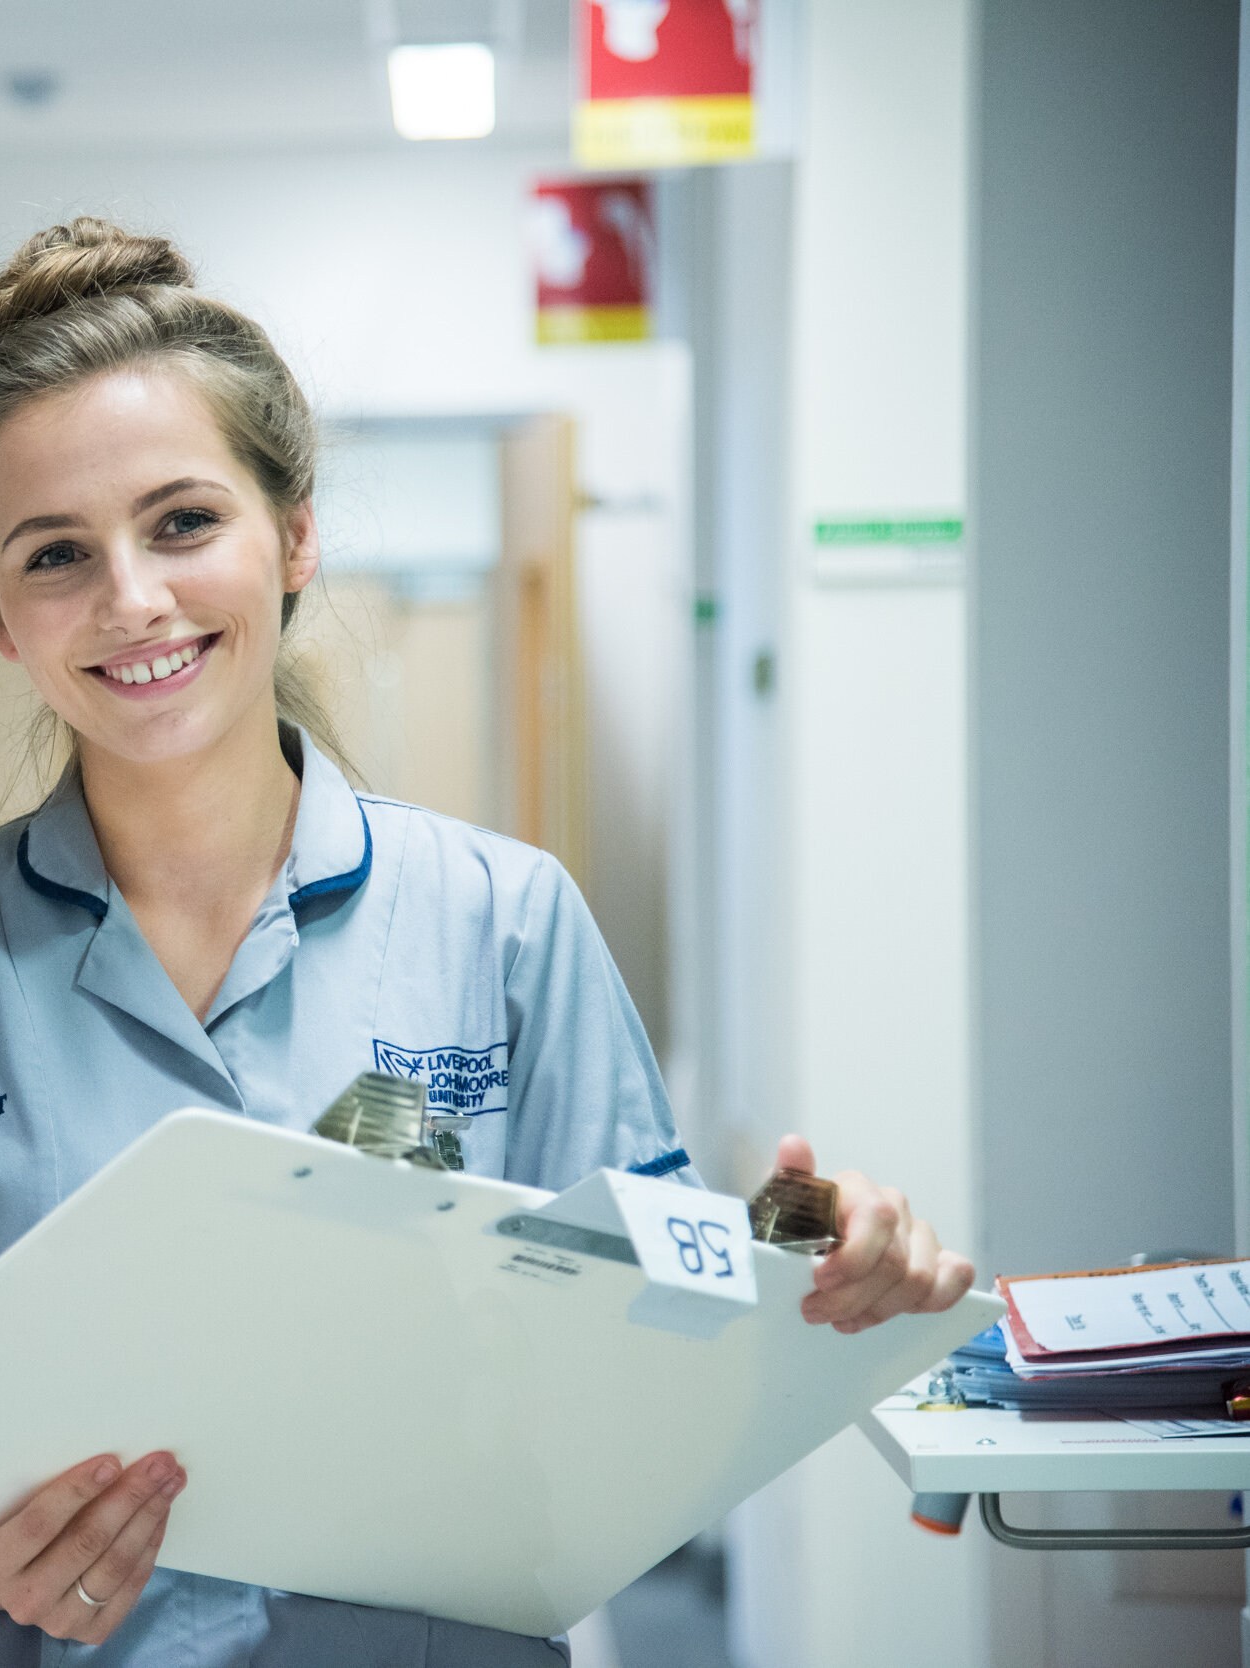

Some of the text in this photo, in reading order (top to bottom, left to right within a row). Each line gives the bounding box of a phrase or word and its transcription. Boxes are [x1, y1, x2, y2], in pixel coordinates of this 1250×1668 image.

[428, 1053, 495, 1073] LIVEPOOL
[427, 1070, 509, 1093] JOH MOORE
[667, 1216, 735, 1278] 58
